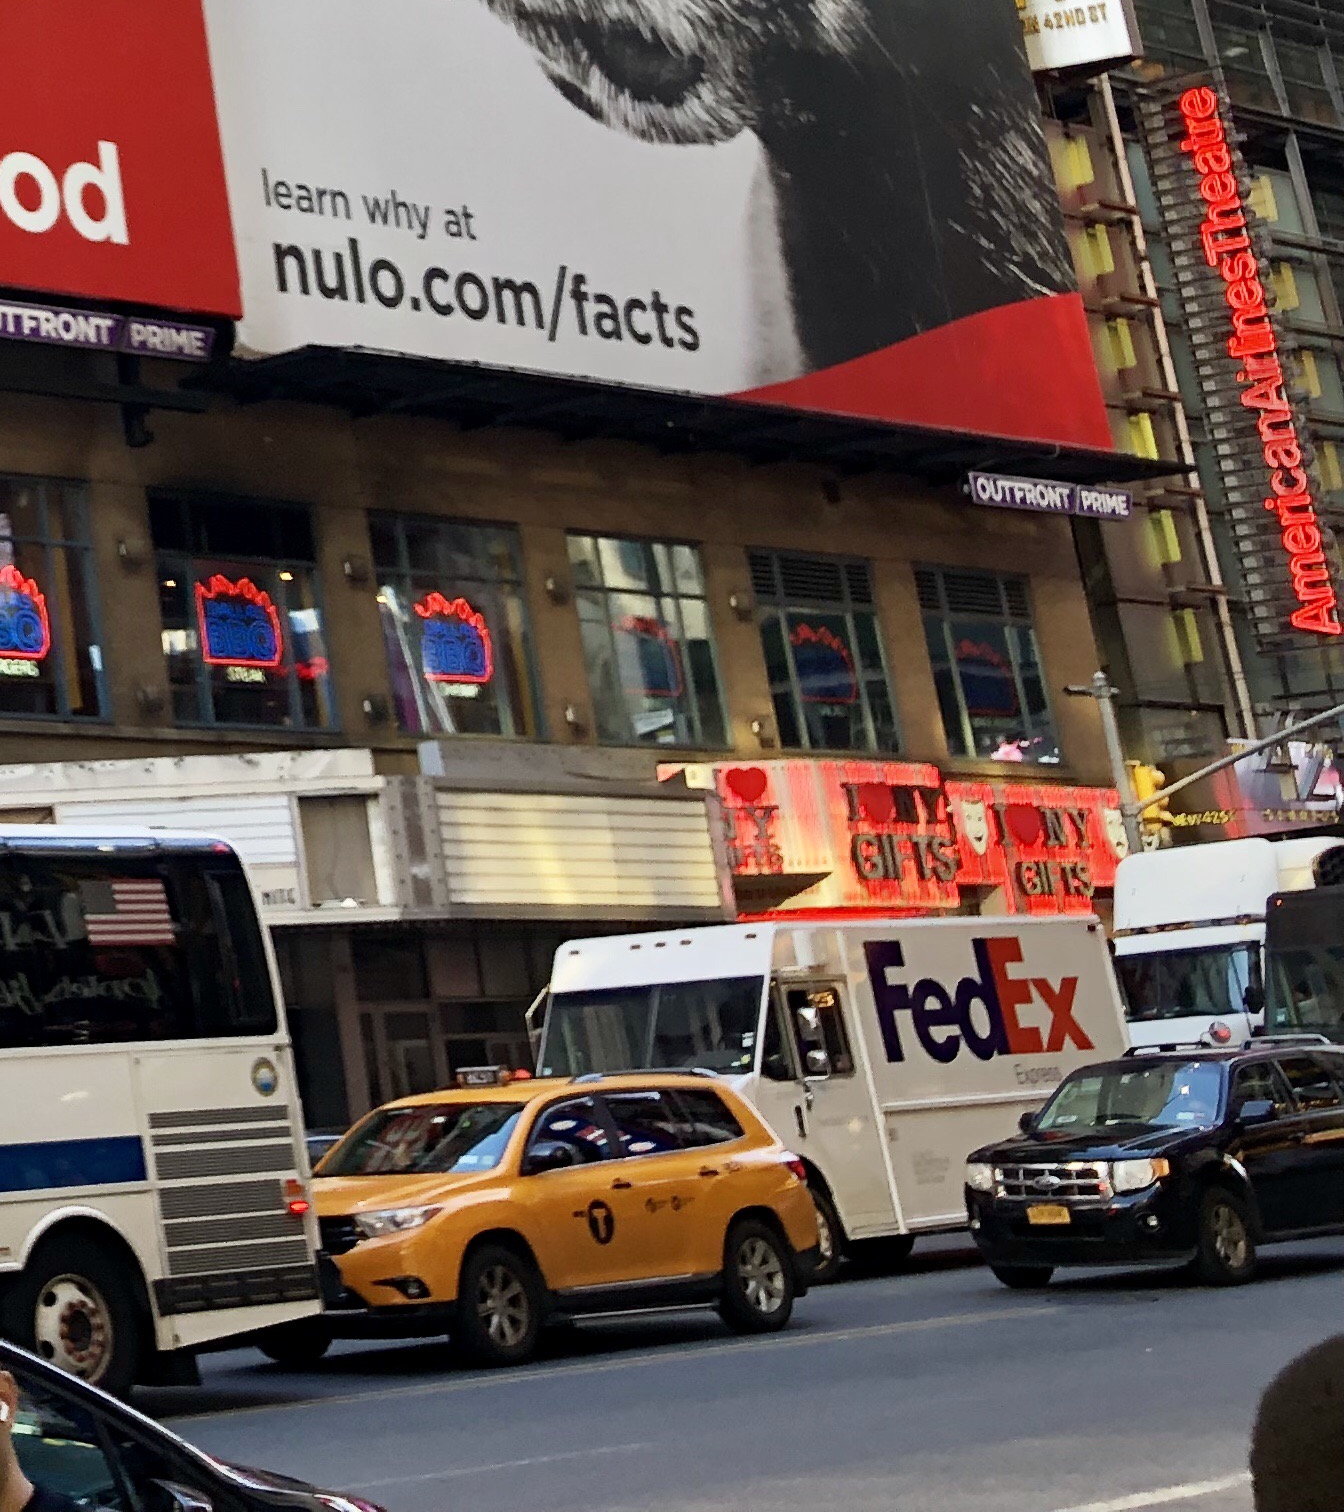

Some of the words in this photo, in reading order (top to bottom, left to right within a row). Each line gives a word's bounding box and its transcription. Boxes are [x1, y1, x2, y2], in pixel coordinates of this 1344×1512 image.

[1044, 8, 1086, 30] 42ND
[1179, 85, 1250, 266] Theatre
[261, 168, 352, 220] learn
[362, 189, 430, 240] why
[444, 204, 477, 241] at
[273, 237, 701, 352] nulo.com/facts
[130, 322, 207, 357] PRIME
[977, 475, 1072, 513] OUTFRONT
[1080, 489, 1131, 517] PRIME
[1258, 404, 1343, 636] American
[891, 784, 946, 825] NY
[1040, 806, 1093, 850] NY
[852, 833, 960, 882] GIFTS
[1016, 860, 1096, 897] GIFTS
[863, 936, 1096, 1064] FedEx
